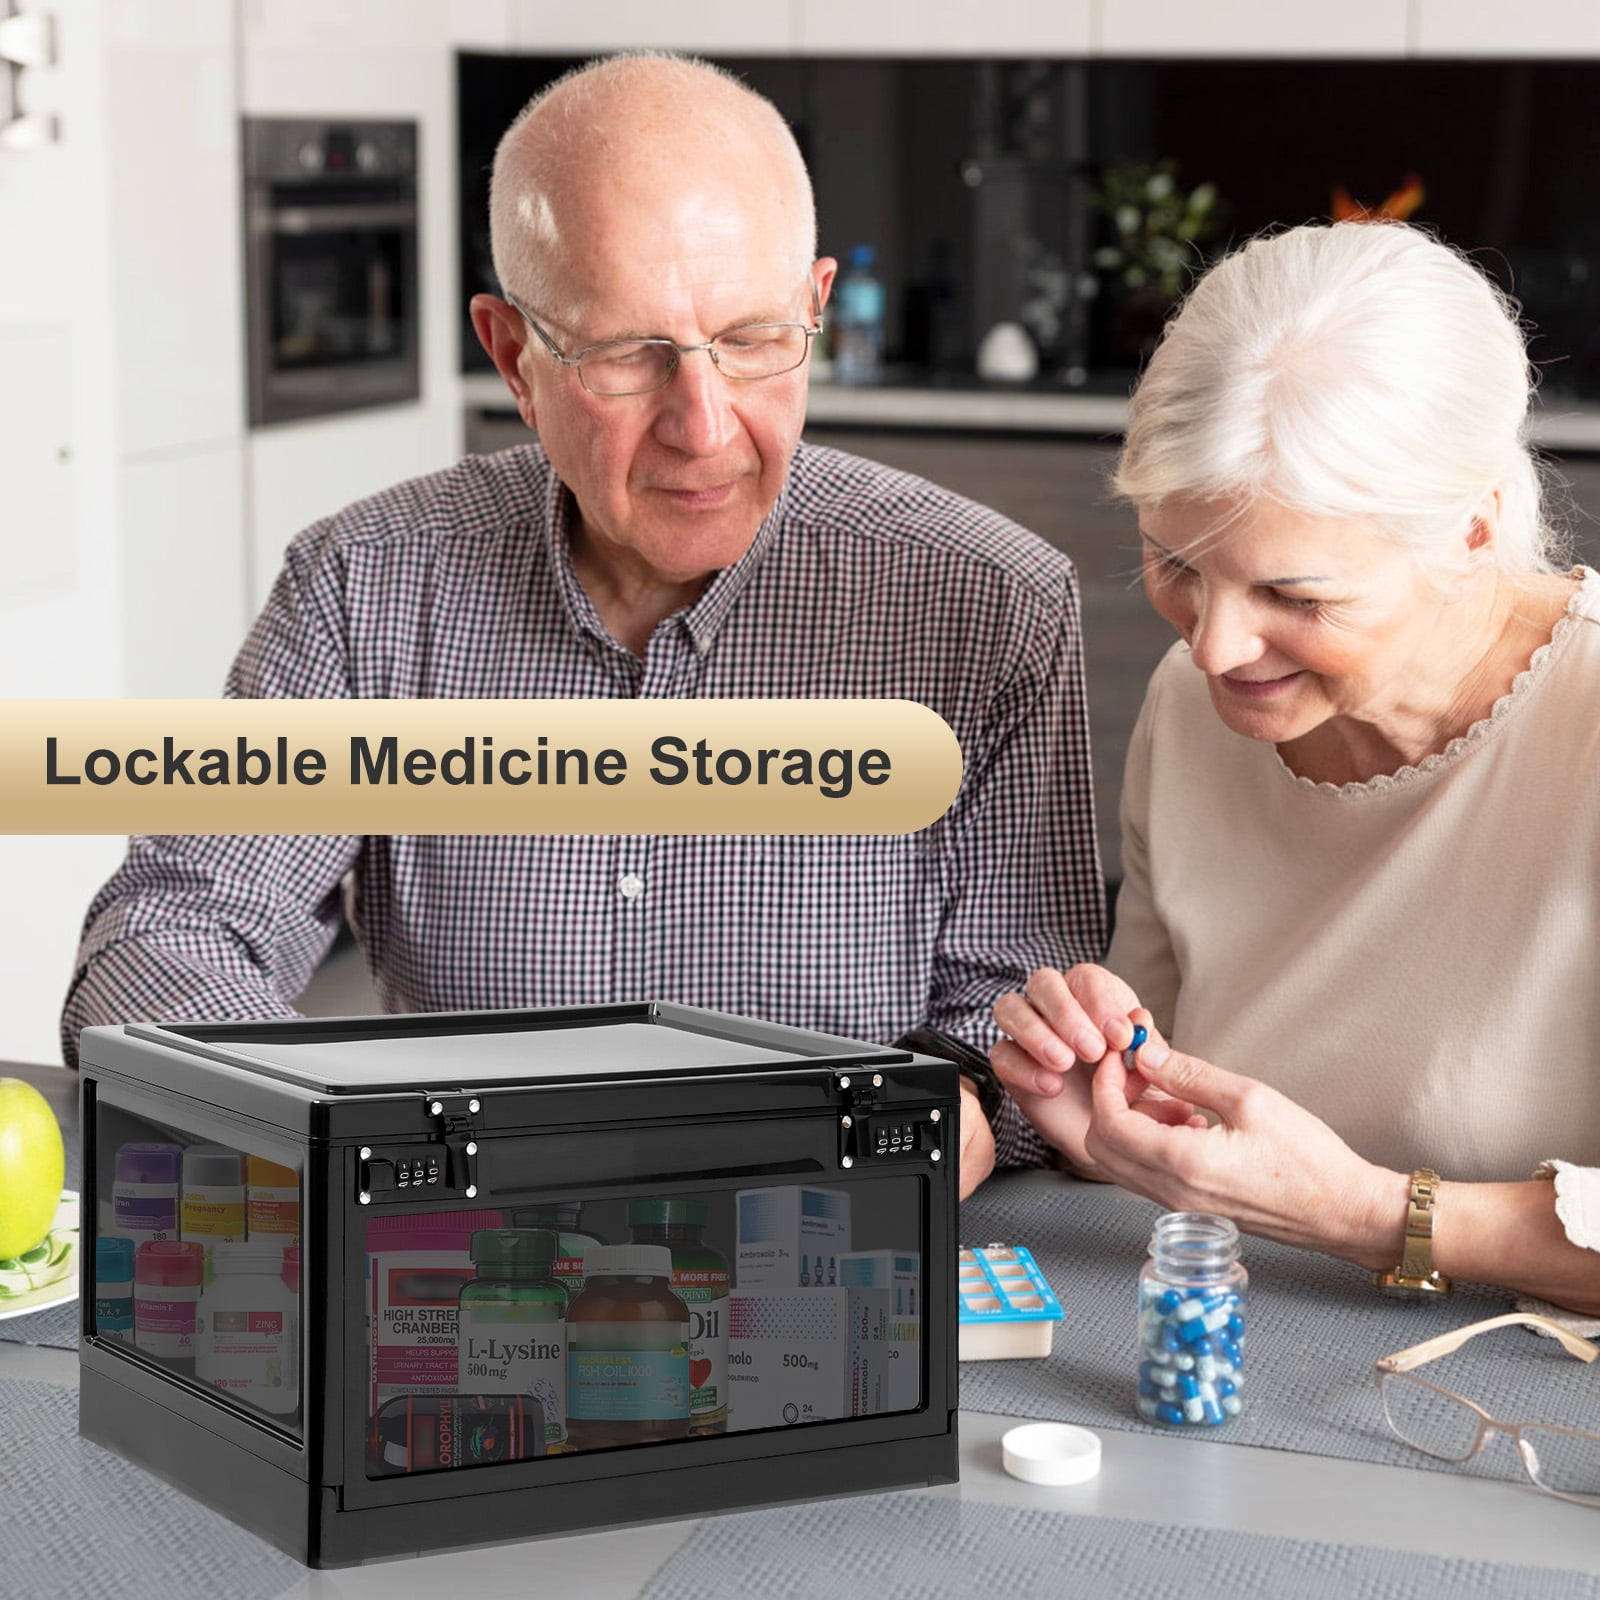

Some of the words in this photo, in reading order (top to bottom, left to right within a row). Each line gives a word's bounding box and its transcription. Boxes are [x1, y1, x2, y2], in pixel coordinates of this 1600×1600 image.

[184, 1203, 226, 1214] Pregnancy
[152, 1232, 167, 1240] 180
[553, 1262, 570, 1270] UE
[680, 1272, 709, 1281] MORE
[562, 1279, 585, 1288] OUNT
[681, 1290, 708, 1300] OUNTY
[139, 1302, 167, 1311] Vitamin
[384, 1309, 414, 1321] HIGH
[255, 1320, 277, 1329] ZINC
[179, 1336, 190, 1345] 60
[417, 1336, 456, 1345] 25,000mg
[405, 1349, 429, 1357] HELPS
[467, 1338, 561, 1365] L-Lysine
[578, 1365, 600, 1377] FISH
[602, 1365, 627, 1377] OIL
[802, 1404, 813, 1413] 24
[439, 1399, 452, 1468] OROPHYLL
